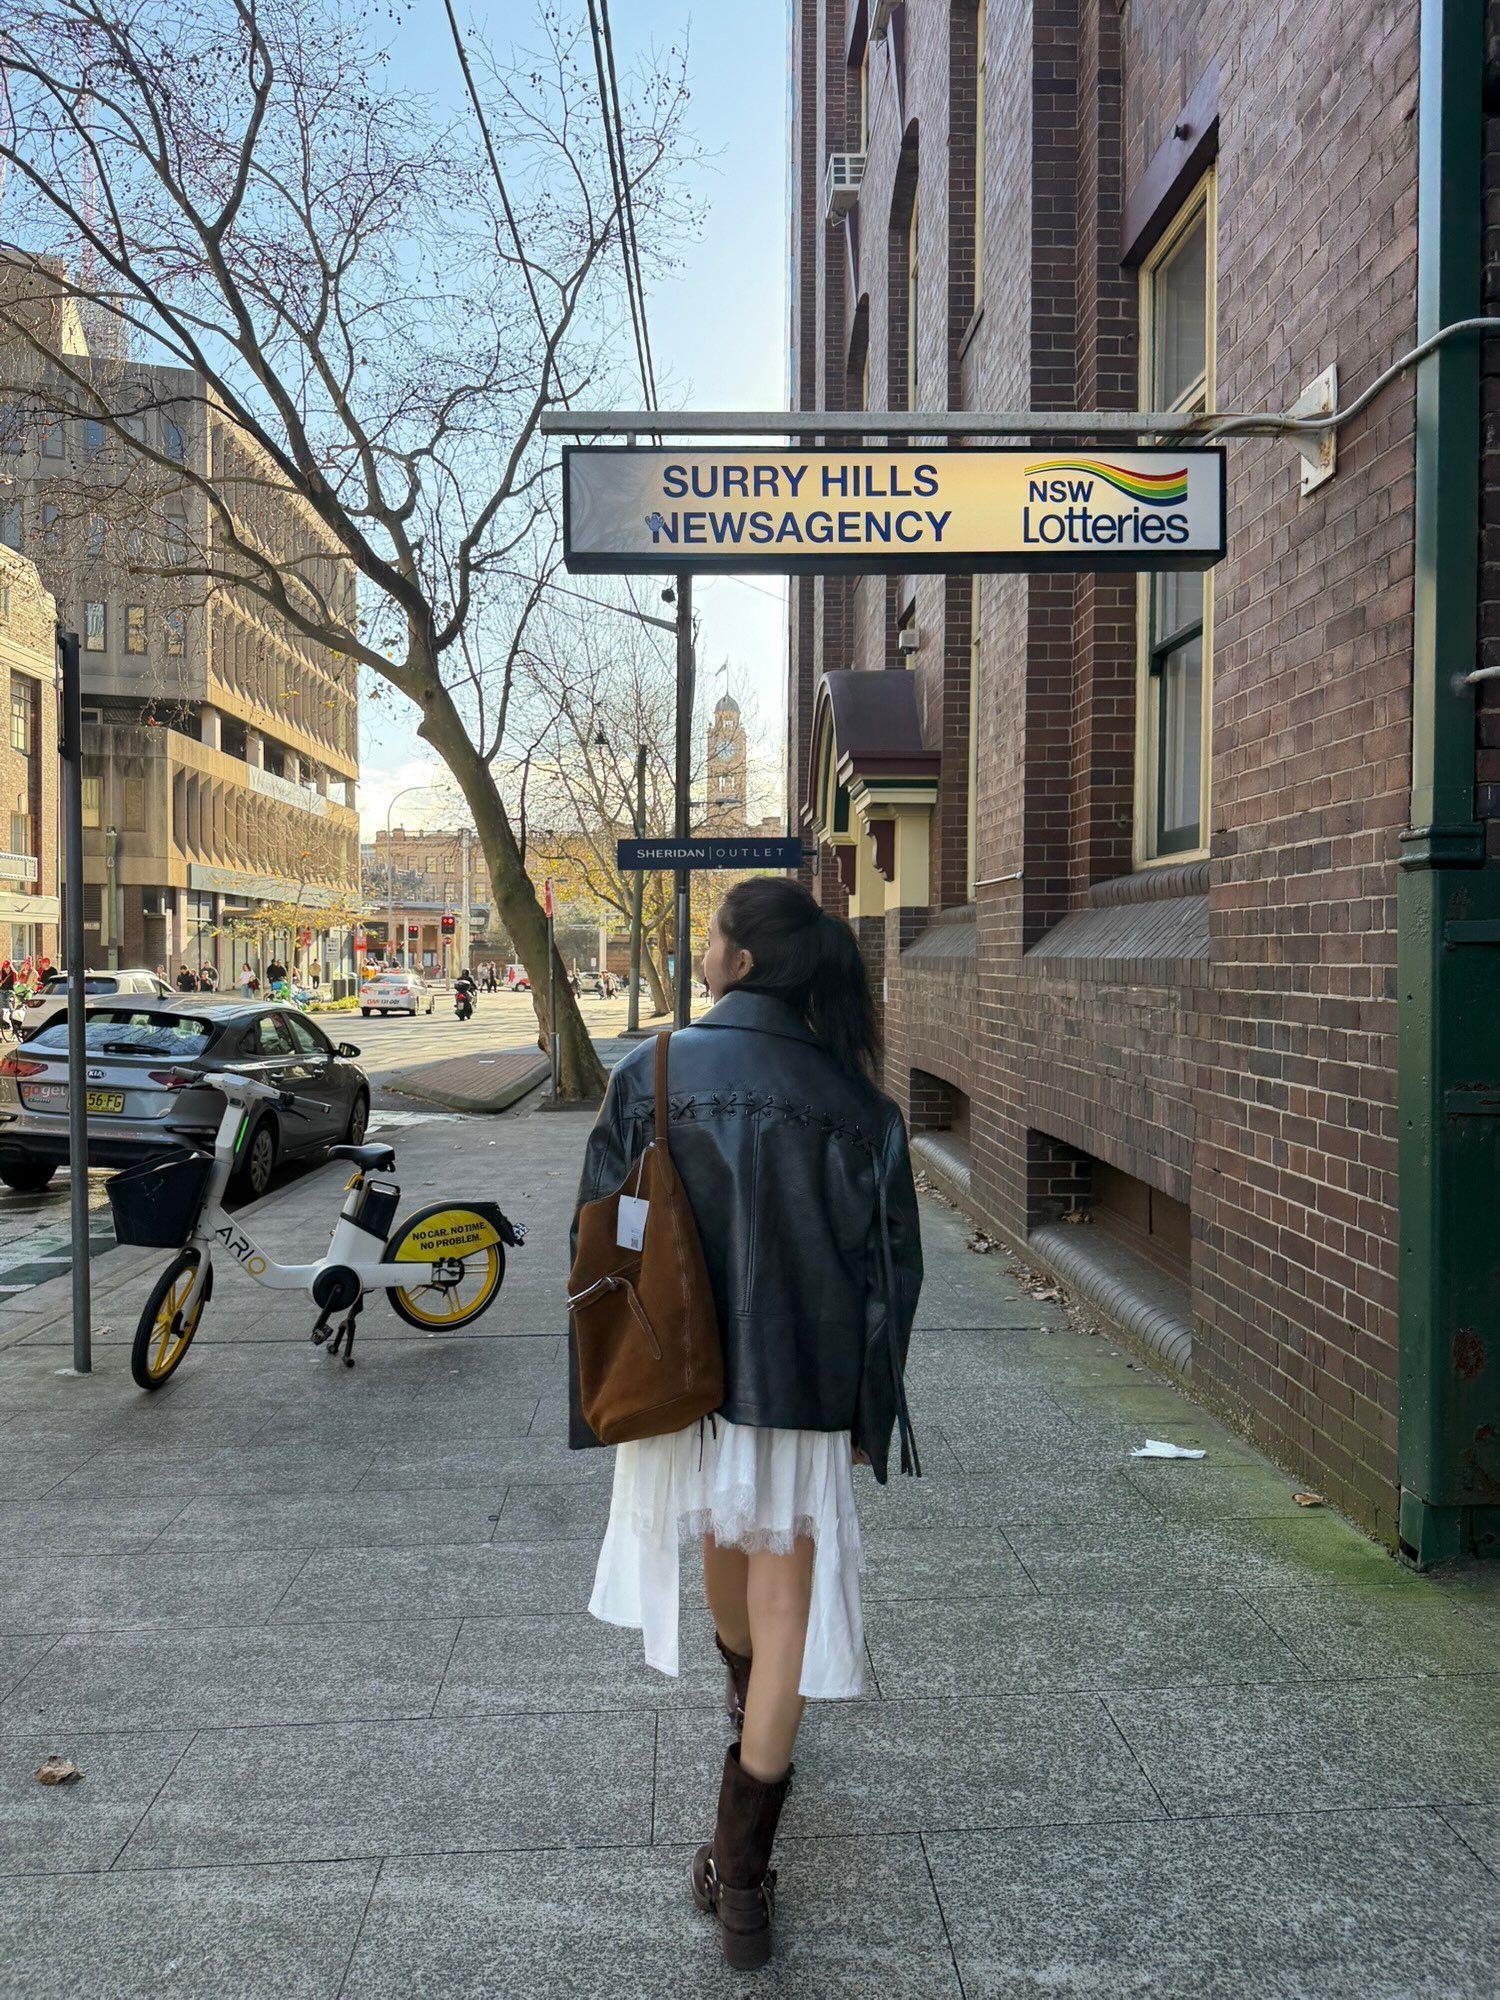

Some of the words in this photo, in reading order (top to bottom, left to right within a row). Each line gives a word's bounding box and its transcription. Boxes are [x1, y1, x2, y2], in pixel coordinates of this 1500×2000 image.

[662, 464, 808, 498] SURRY
[821, 464, 939, 497] HILLS
[1029, 480, 1094, 502] NSW
[651, 510, 952, 544] NEWSAGENCY
[1023, 506, 1190, 544] Lotteries
[637, 848, 705, 859] SHERIDAN
[716, 847, 784, 857] OUTLET
[88, 1070, 104, 1078] KIA
[412, 1231, 427, 1241] NO
[427, 1228, 450, 1238] CAR.
[450, 1225, 464, 1235] NO
[420, 1241, 435, 1250] NO
[435, 1233, 482, 1248] PROBLEM.
[215, 1226, 267, 1275] ARIO
